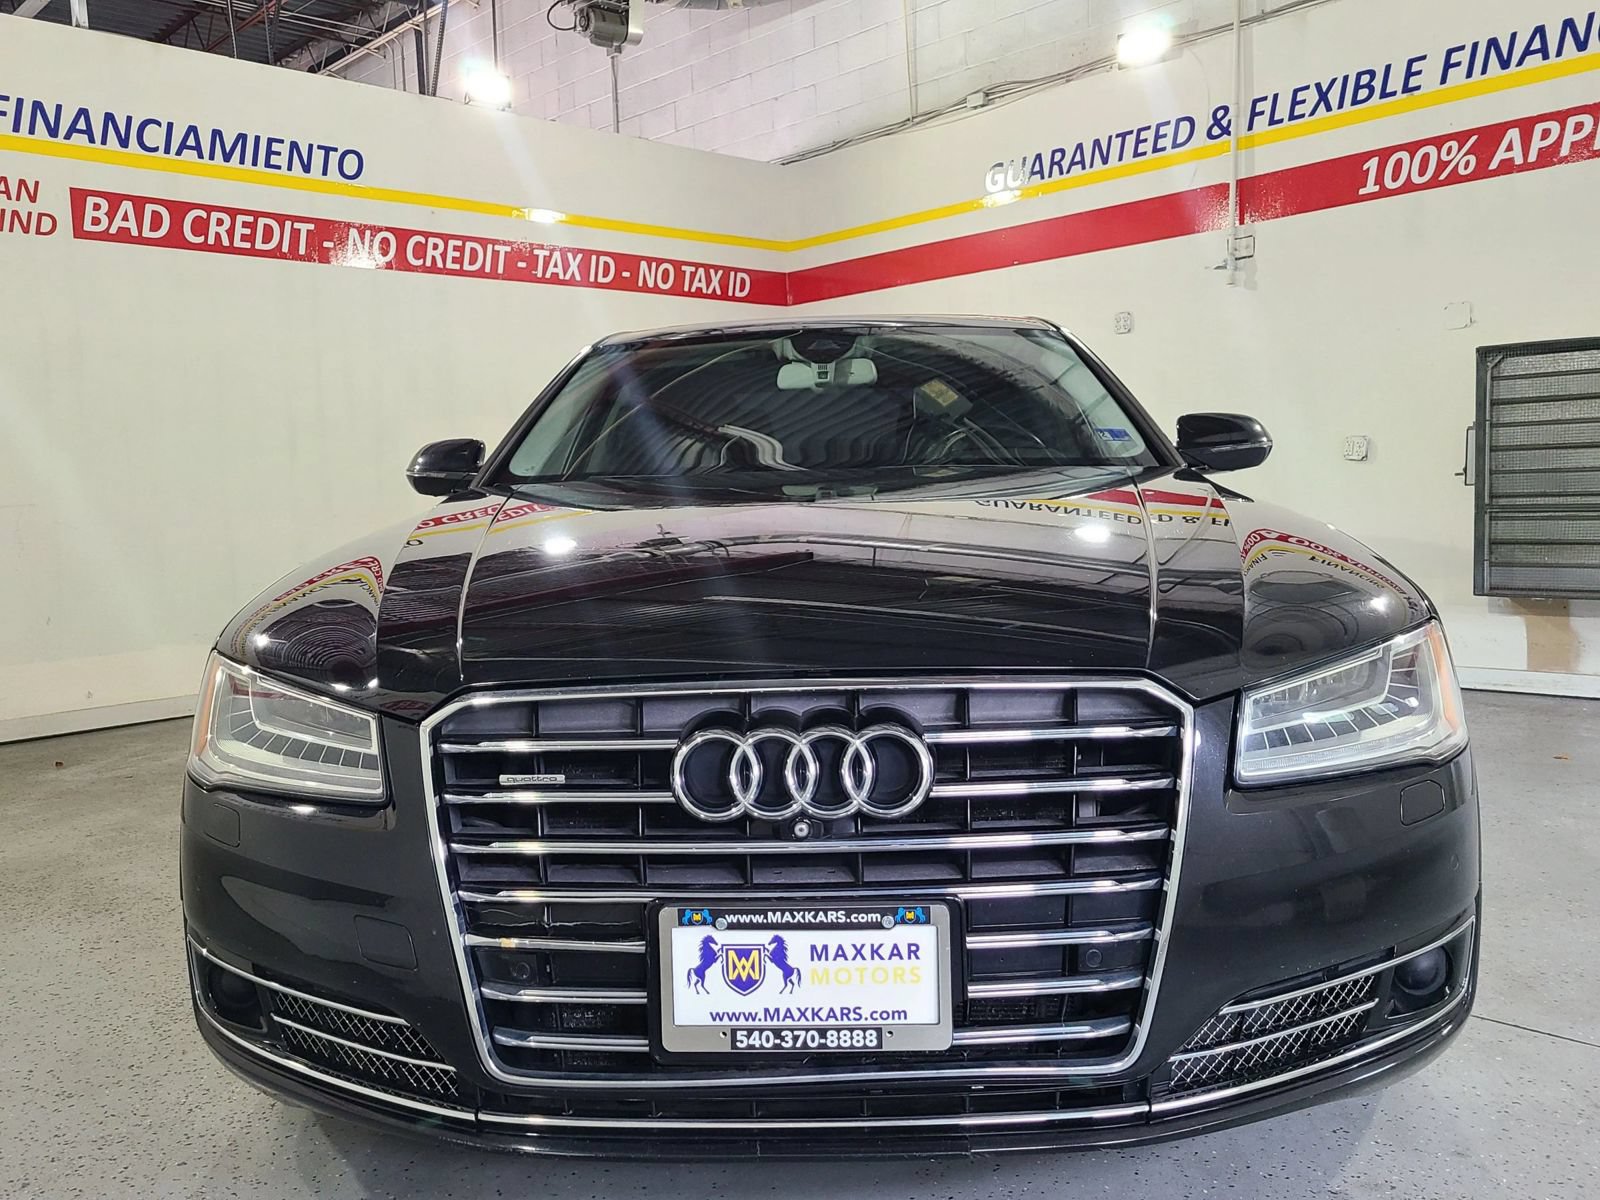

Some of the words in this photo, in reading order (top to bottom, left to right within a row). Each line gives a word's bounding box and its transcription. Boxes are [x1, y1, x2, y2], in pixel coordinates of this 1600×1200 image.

[984, 115, 1196, 194] GUARANTEED
[1206, 104, 1232, 140] &
[1247, 54, 1428, 132] FLEXIBLE
[1440, 12, 1600, 85] FINAN
[1358, 134, 1479, 195] 100%
[1488, 113, 1600, 170] APP
[83, 196, 171, 239] BAD
[182, 208, 315, 255] CREDIT
[349, 228, 397, 264] NO
[406, 235, 511, 274] CREDIT
[533, 249, 583, 281] TAX
[589, 255, 615, 283] ID
[638, 260, 675, 290] NO
[681, 265, 722, 296] TAX
[728, 271, 750, 297] ID
[506, 775, 558, 784] quattro
[725, 910, 882, 925] www.MAXKARS.com
[809, 943, 921, 962] MAXKAR
[809, 966, 921, 986] MOTORS
[710, 1006, 908, 1023] www.MAXKARS.com
[735, 1029, 878, 1049] 540-370-8888
